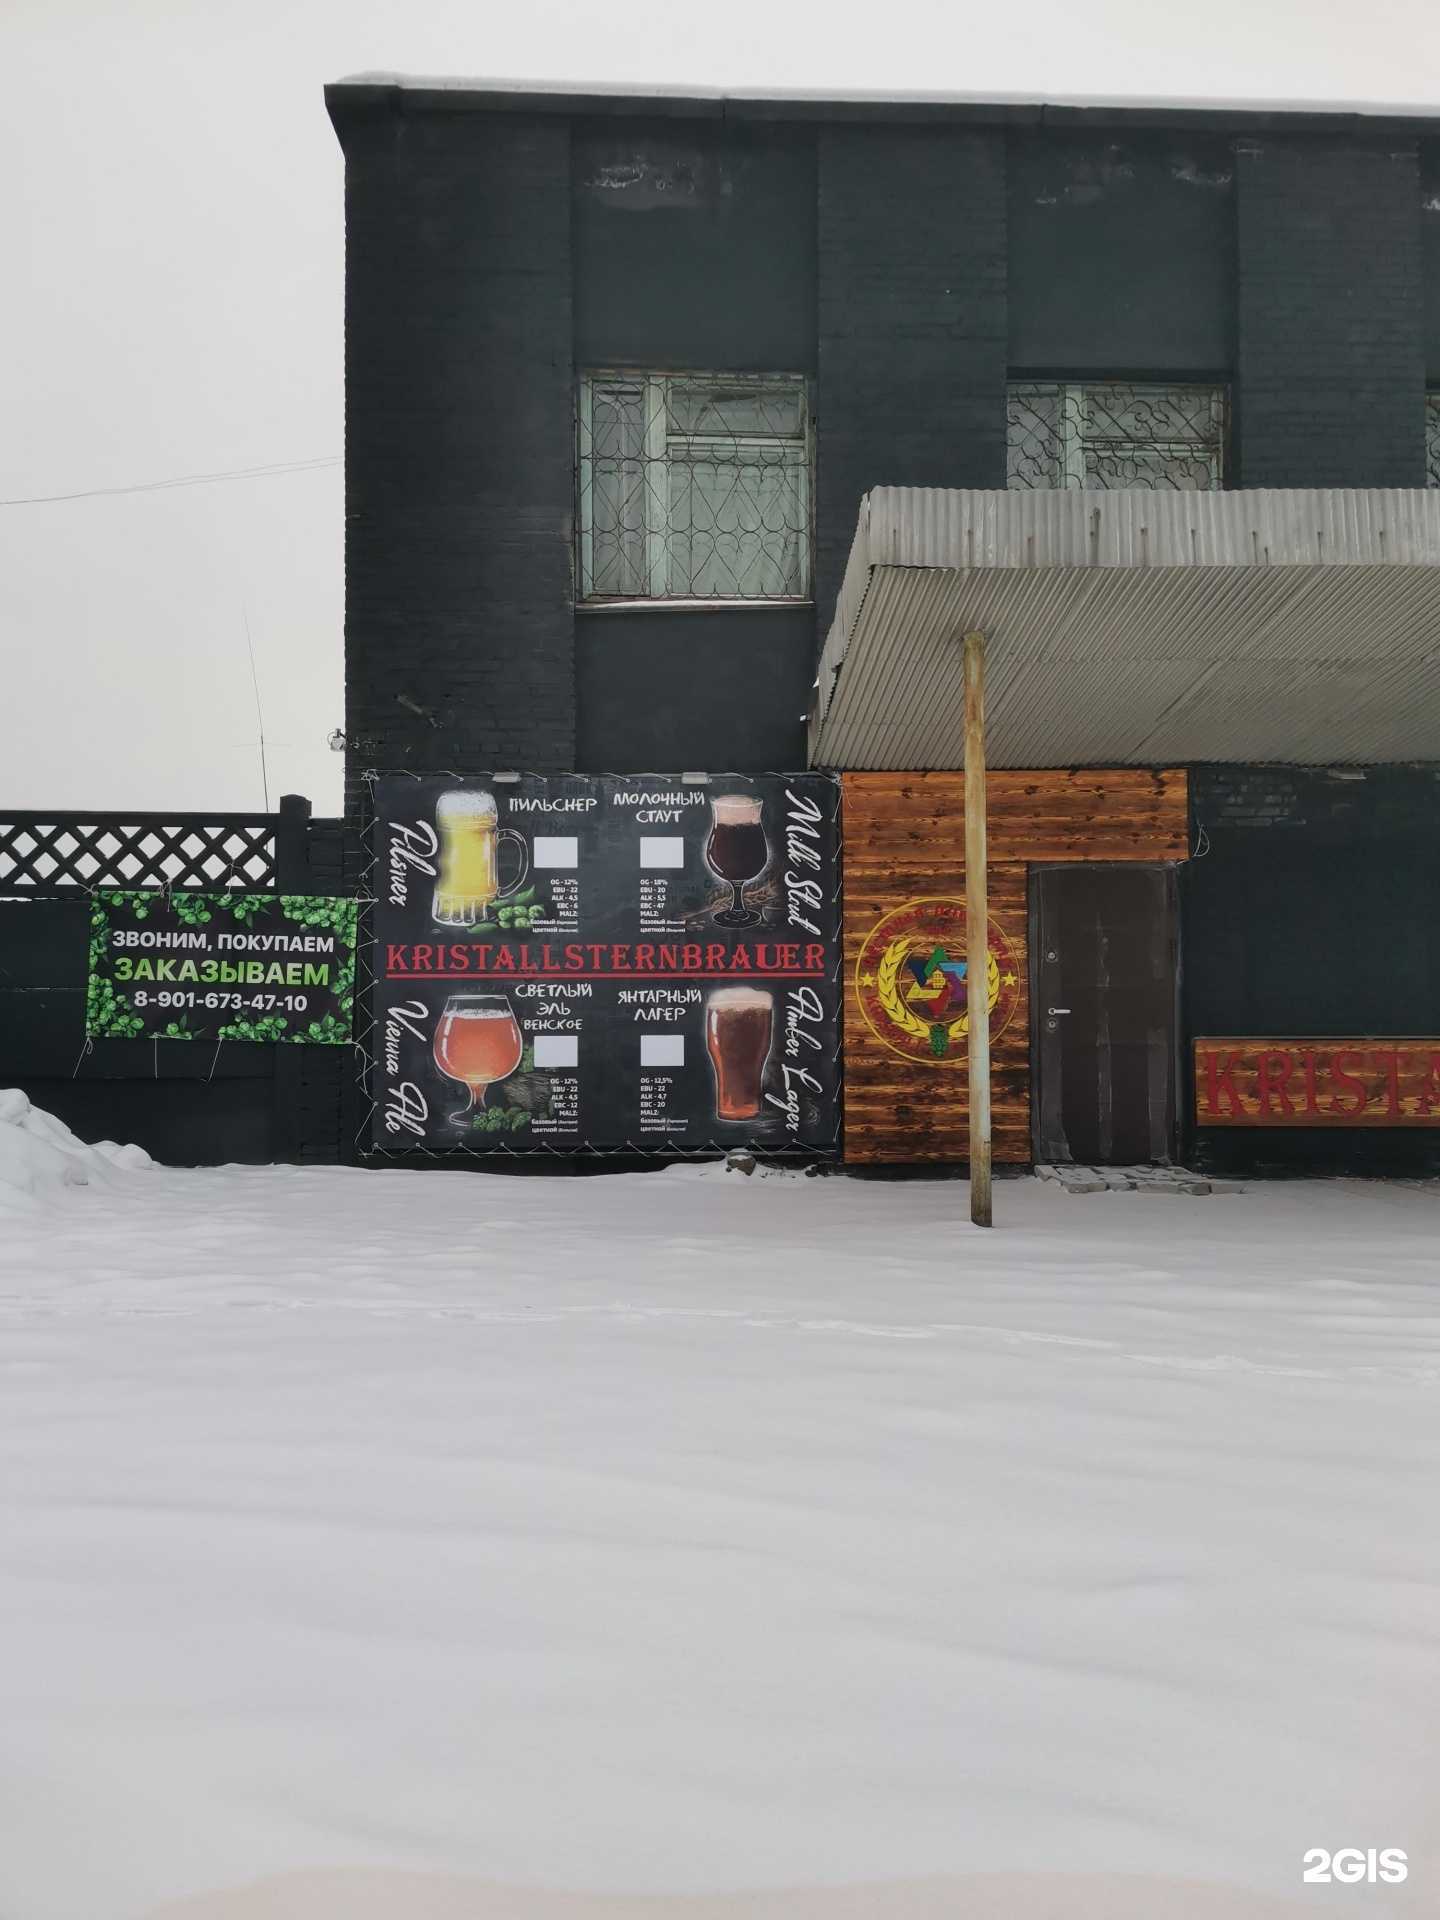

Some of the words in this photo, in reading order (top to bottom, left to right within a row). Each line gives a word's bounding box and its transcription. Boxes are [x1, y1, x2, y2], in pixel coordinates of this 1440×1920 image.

[509, 798, 597, 812] ПИЛЬСНЕР
[613, 792, 705, 806] МОЛОЧНЫЙ
[635, 809, 683, 823] СТАУТ
[784, 788, 823, 871] Milk
[388, 820, 438, 907] Pilsner
[784, 870, 823, 936] Stout
[112, 930, 213, 951] ЗВОНИМ,
[217, 933, 334, 952] ПОКУПАЕМ
[386, 943, 825, 971] KRISTALLSTERNBRAUER
[113, 957, 330, 986] ЗАКАЗЫВАЕМ
[515, 983, 593, 997] СВЕТЛЫЙ
[618, 989, 702, 1004] ЯНТАРНЫЙ
[134, 991, 308, 1012] 8-901-673-47-10
[536, 1002, 571, 1015] ЭЛЬ
[523, 1019, 583, 1030] ВЕНСКОЕ
[634, 1007, 686, 1021] ЛАГЕР
[785, 986, 824, 1057] Amber
[385, 1000, 429, 1076] Vienna
[764, 1063, 824, 1132] Lager
[385, 1082, 429, 1137] Ale
